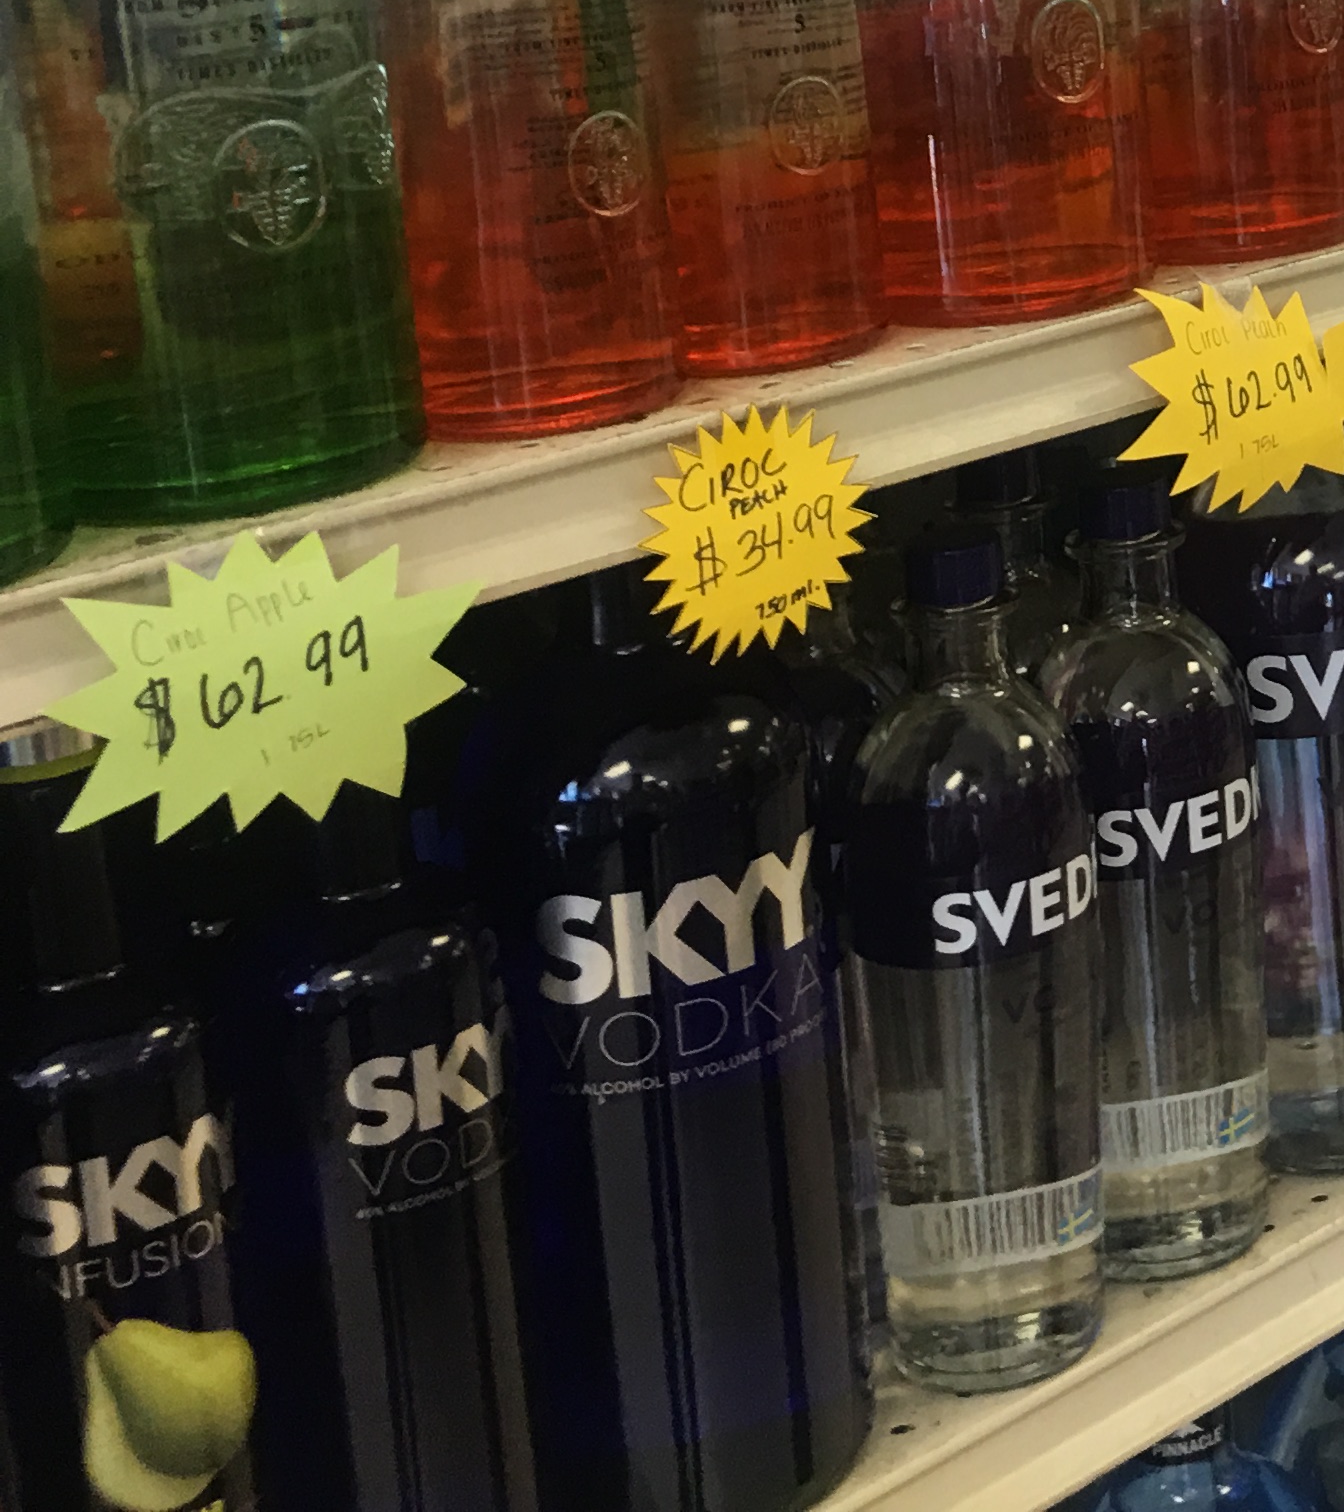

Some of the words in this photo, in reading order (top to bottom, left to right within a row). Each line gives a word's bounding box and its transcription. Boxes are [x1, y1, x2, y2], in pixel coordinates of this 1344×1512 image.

[677, 446, 788, 514] CIROC
[728, 481, 789, 521] PEACH
[535, 825, 816, 1006] SKYY
[553, 952, 824, 1071] VODKA
[669, 1071, 690, 1086] BY
[695, 1047, 763, 1079] VOLUME
